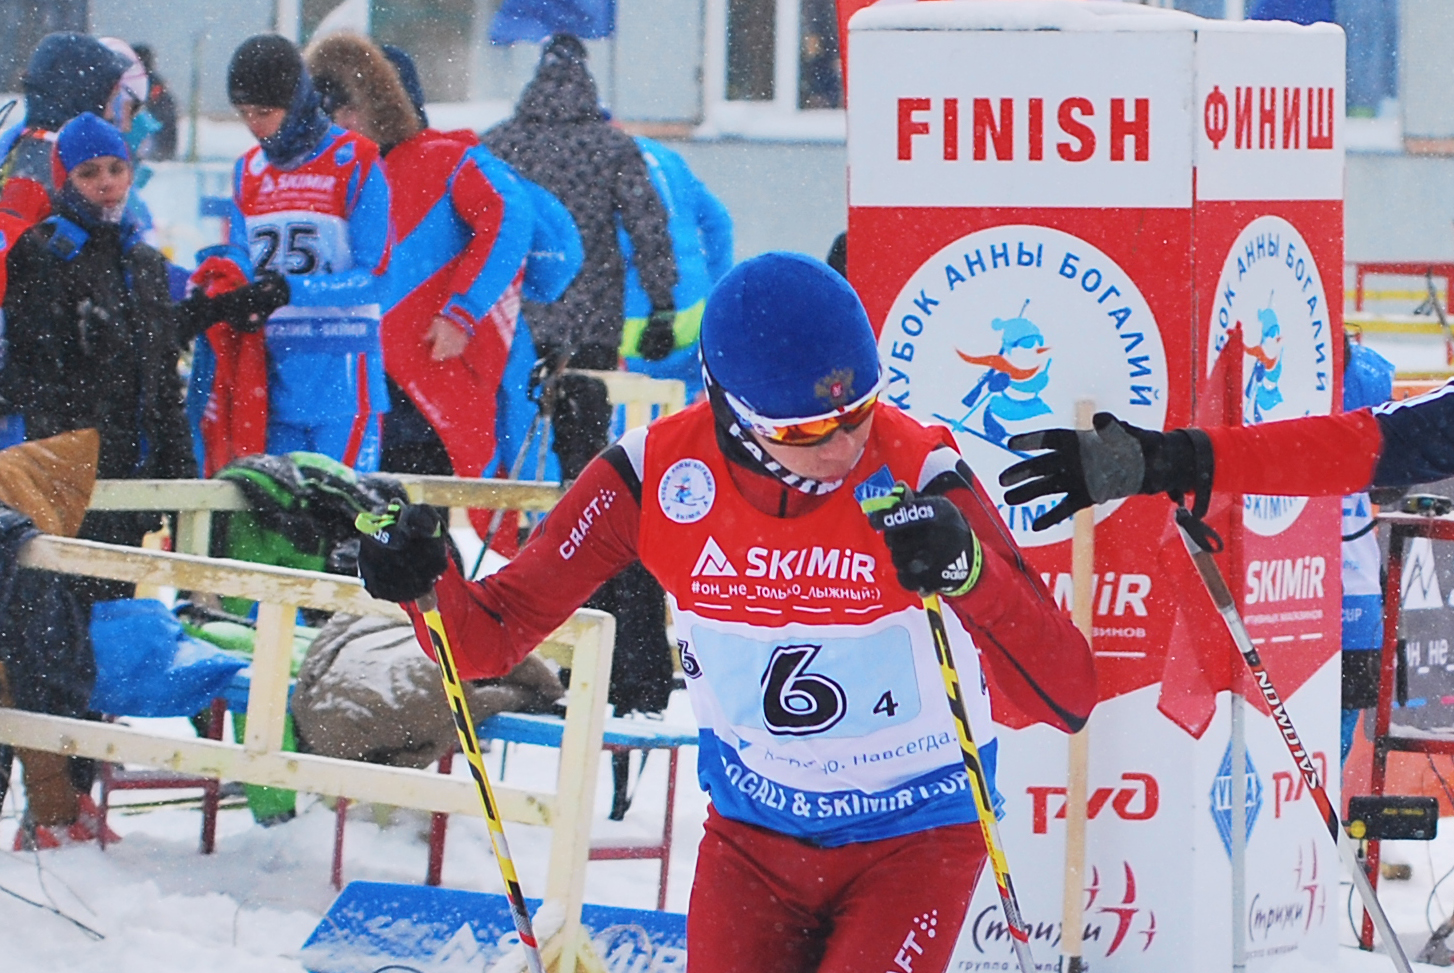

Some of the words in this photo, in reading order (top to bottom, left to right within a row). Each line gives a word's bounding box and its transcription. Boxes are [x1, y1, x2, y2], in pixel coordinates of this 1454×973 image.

[897, 97, 1150, 162] FINISH
[1205, 85, 1334, 150] ФИНИШ
[888, 289, 940, 410] КУБОК
[944, 241, 1044, 291] АННЫ
[1058, 252, 1161, 407] БОГАЛИЙ
[1237, 232, 1281, 282] АННЫ
[1285, 242, 1330, 392] БОГАЛИЙ
[559, 496, 601, 560] CRAFT
[884, 505, 935, 527] adidas
[745, 546, 877, 584] SKIMiR
[1245, 555, 1326, 605] SKIMiR
[760, 644, 848, 737] 6
[872, 689, 899, 718] 4
[1253, 670, 1320, 790] SALOMON
[791, 792, 812, 819] &
